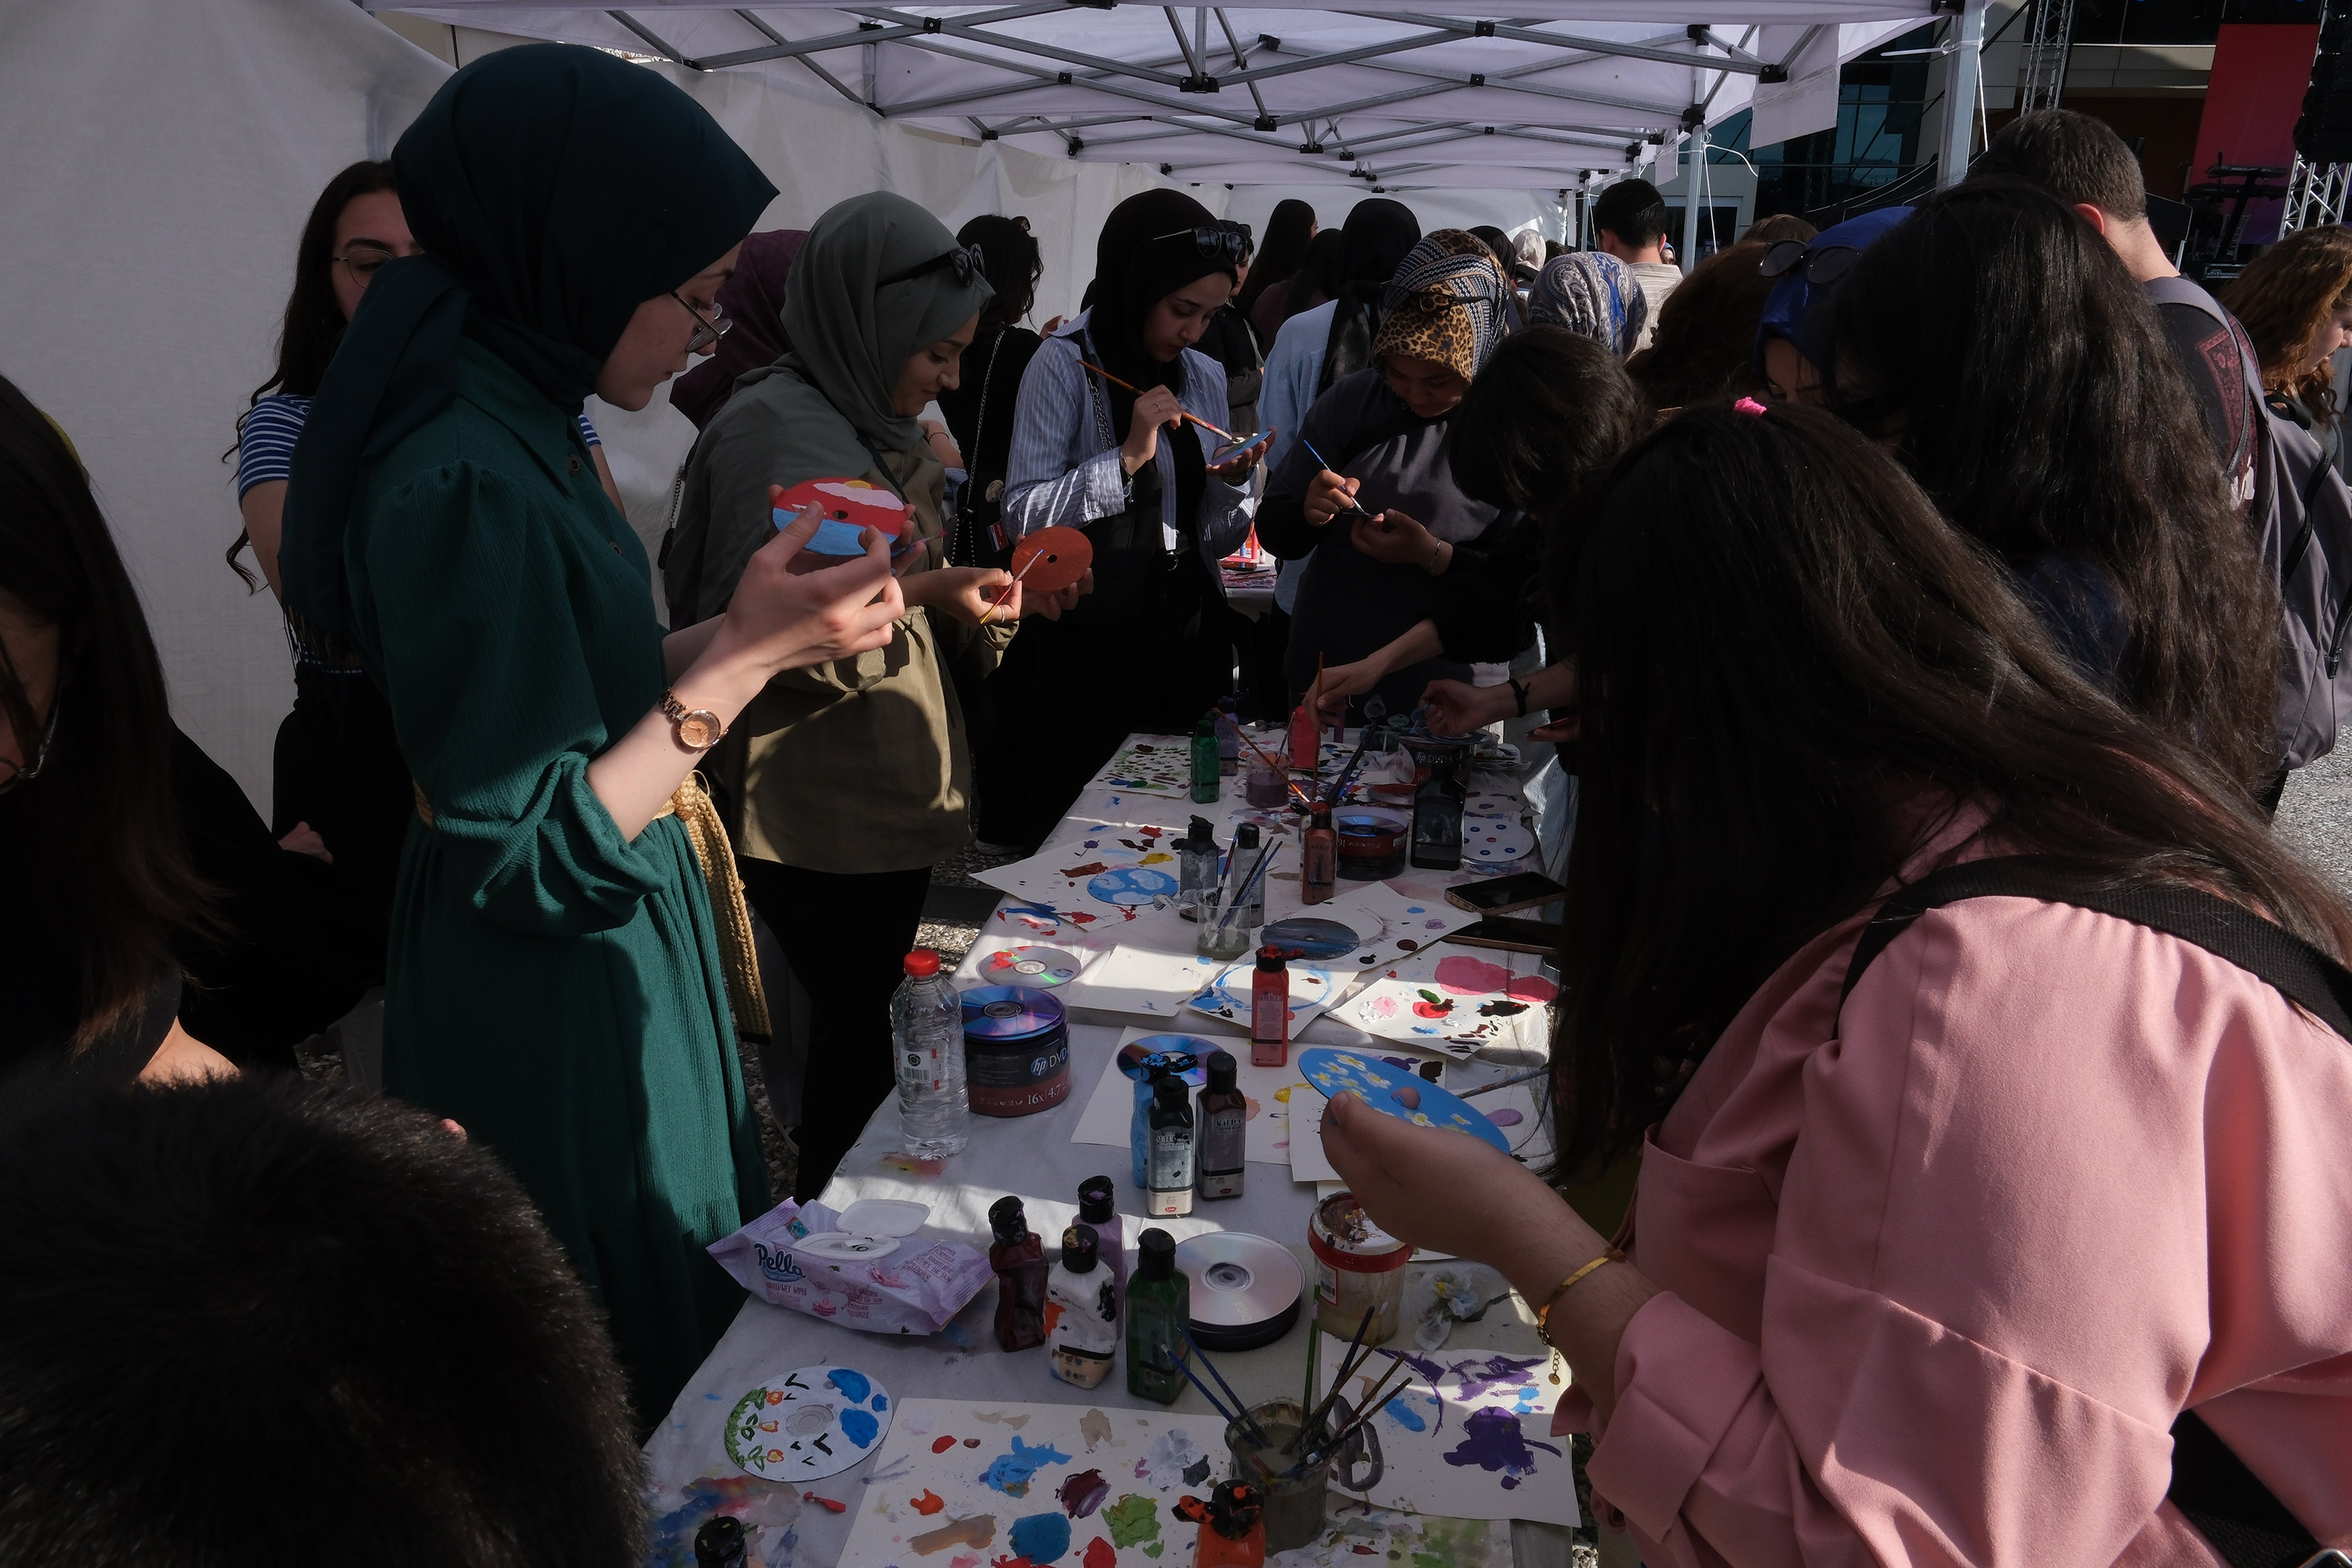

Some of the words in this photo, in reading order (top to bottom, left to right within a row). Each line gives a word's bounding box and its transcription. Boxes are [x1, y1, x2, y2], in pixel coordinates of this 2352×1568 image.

[1417, 753, 1426, 764] hp
[1033, 1058, 1047, 1076] hp
[753, 1243, 807, 1278] Pella
